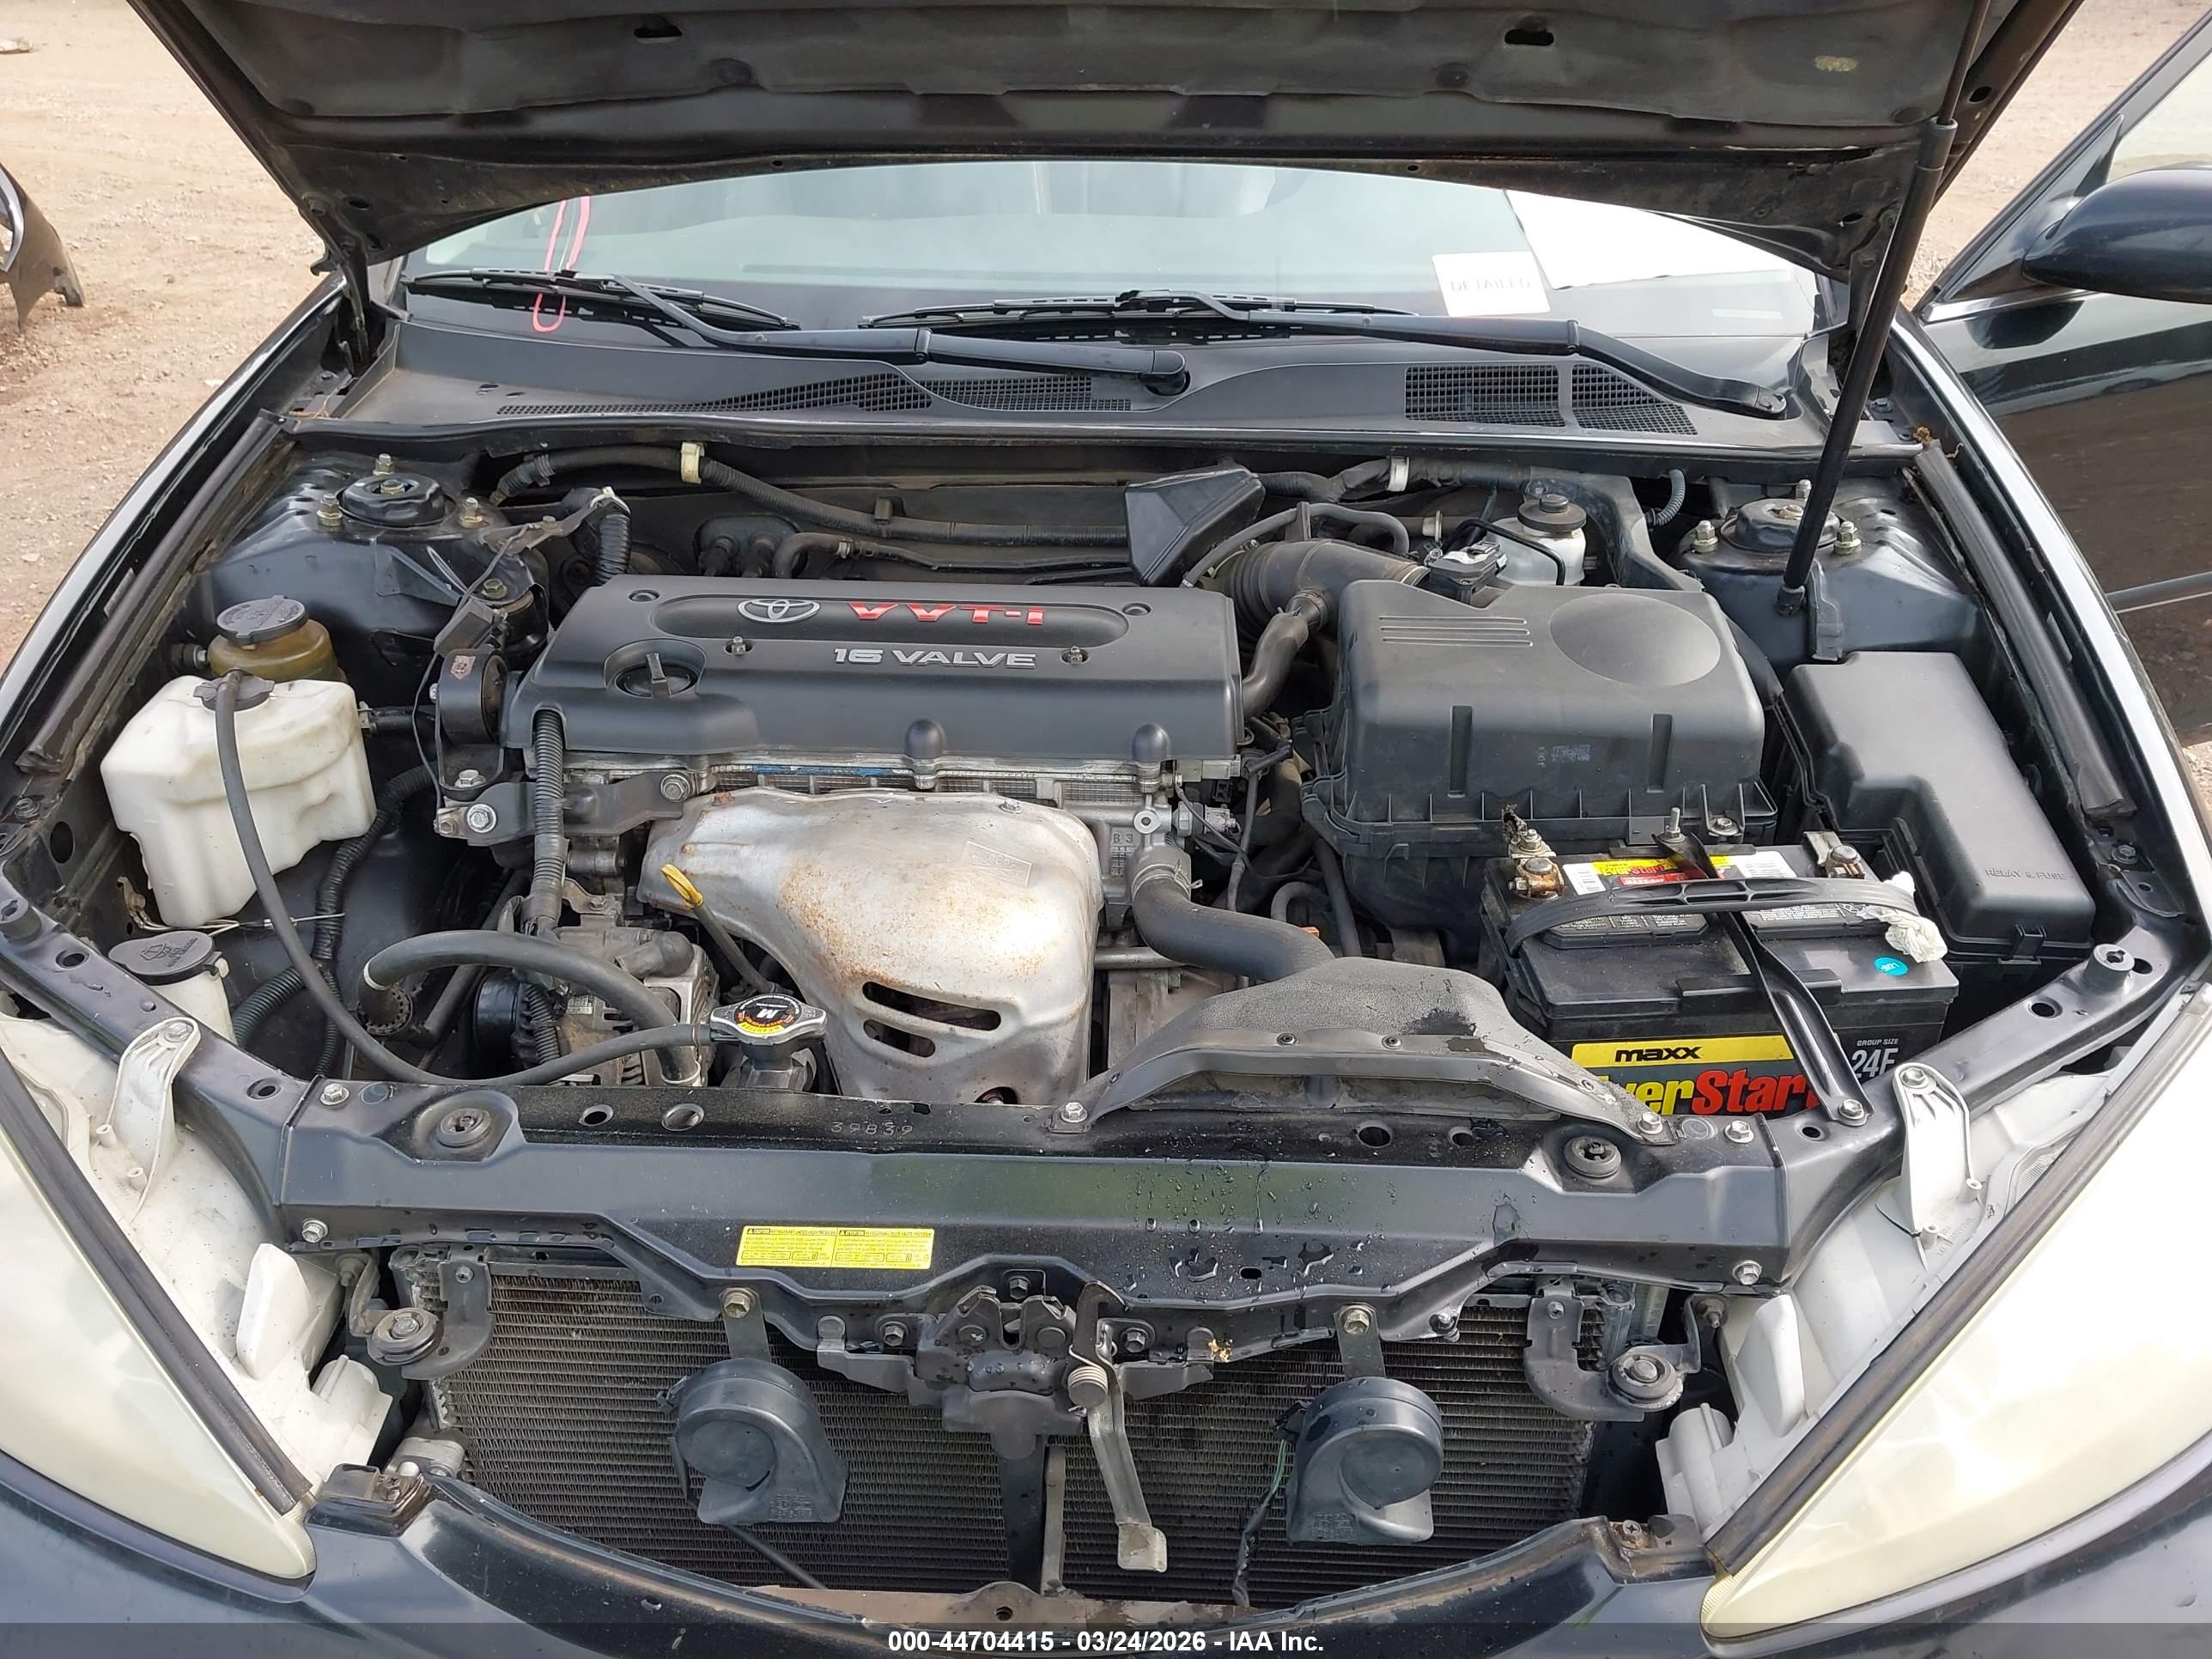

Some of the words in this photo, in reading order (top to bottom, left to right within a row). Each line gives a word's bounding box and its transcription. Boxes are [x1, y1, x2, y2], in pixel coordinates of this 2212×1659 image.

[835, 647, 884, 665] 16
[891, 649, 1036, 670] VALVE
[1984, 868, 2021, 878] RELAY
[2035, 872, 2068, 880] FUSE
[1851, 1048, 1899, 1078] 24F
[830, 1121, 914, 1136] 39839
